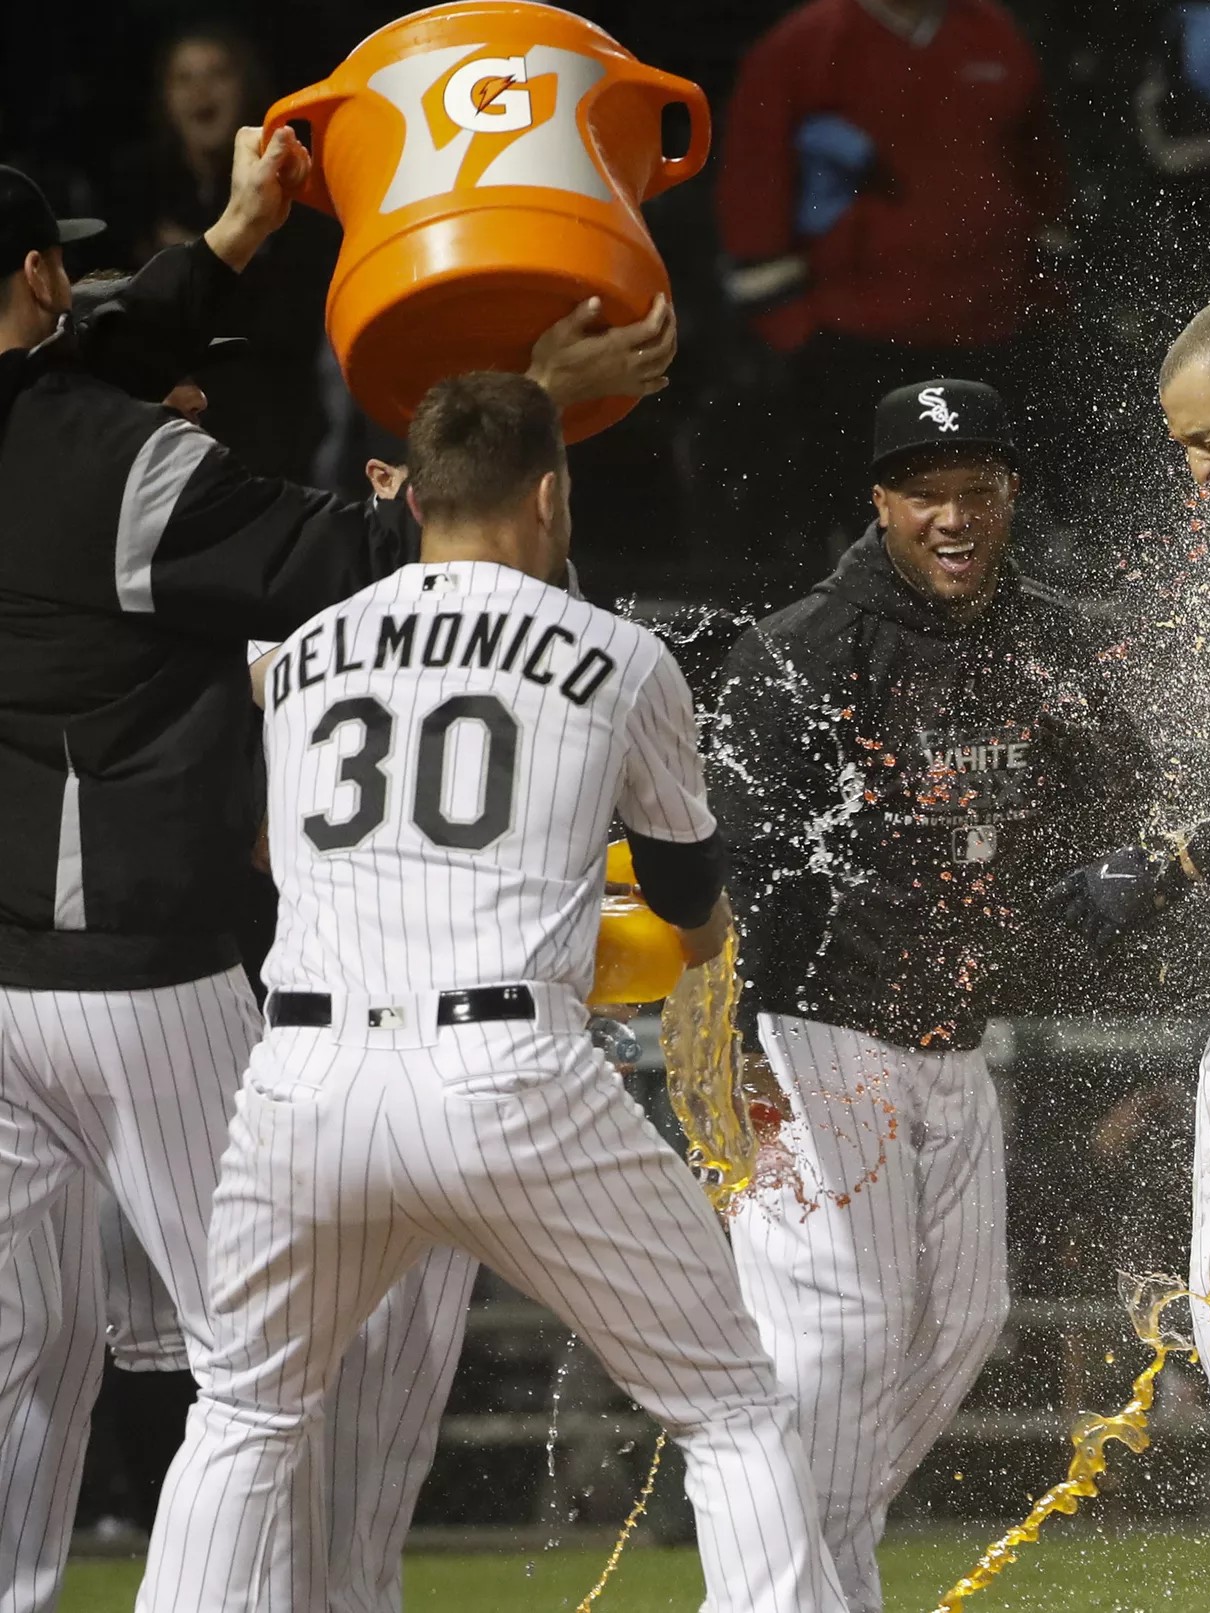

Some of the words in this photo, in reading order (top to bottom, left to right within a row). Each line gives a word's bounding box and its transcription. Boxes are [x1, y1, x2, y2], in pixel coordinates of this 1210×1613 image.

[443, 55, 533, 134] G
[918, 387, 959, 432] Sox
[273, 611, 618, 714] DELMONICO
[301, 691, 523, 856] 30
[921, 742, 1030, 773] WHITE
